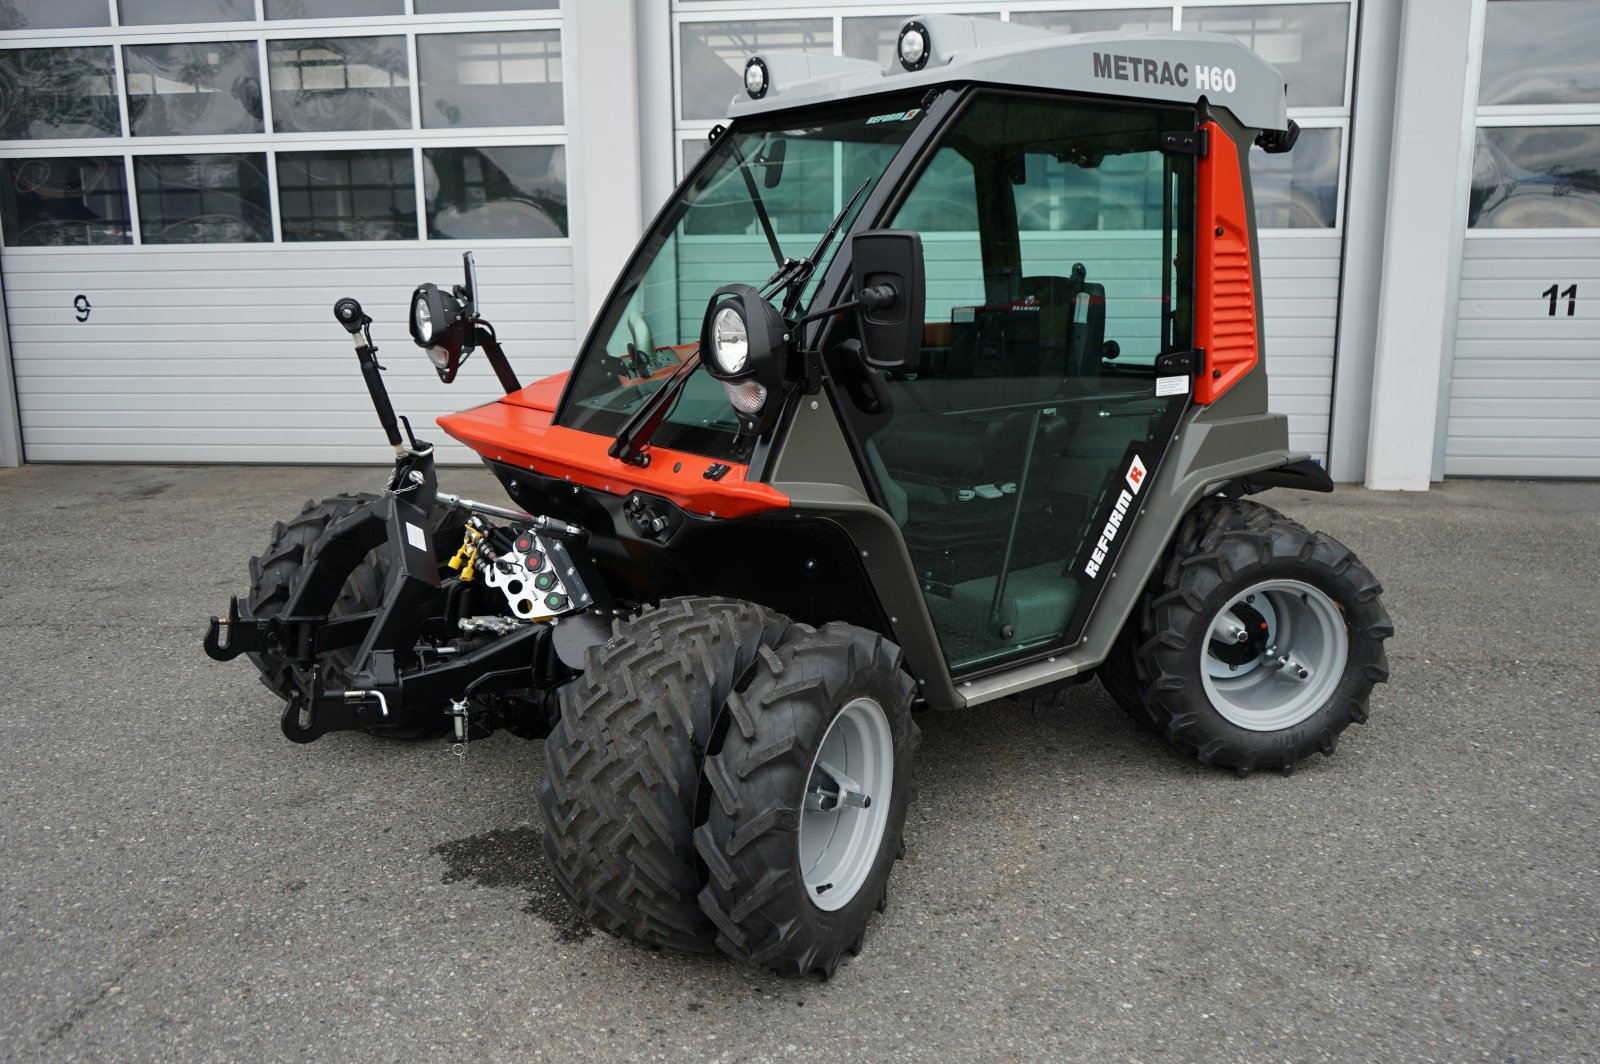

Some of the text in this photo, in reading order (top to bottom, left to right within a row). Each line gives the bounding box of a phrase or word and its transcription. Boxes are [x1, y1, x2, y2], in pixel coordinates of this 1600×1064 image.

[1093, 52, 1236, 94] METRAC H60
[866, 112, 905, 125] REFORM
[74, 294, 92, 323] 9
[1542, 284, 1577, 316] 11
[1084, 489, 1133, 579] REFORM
